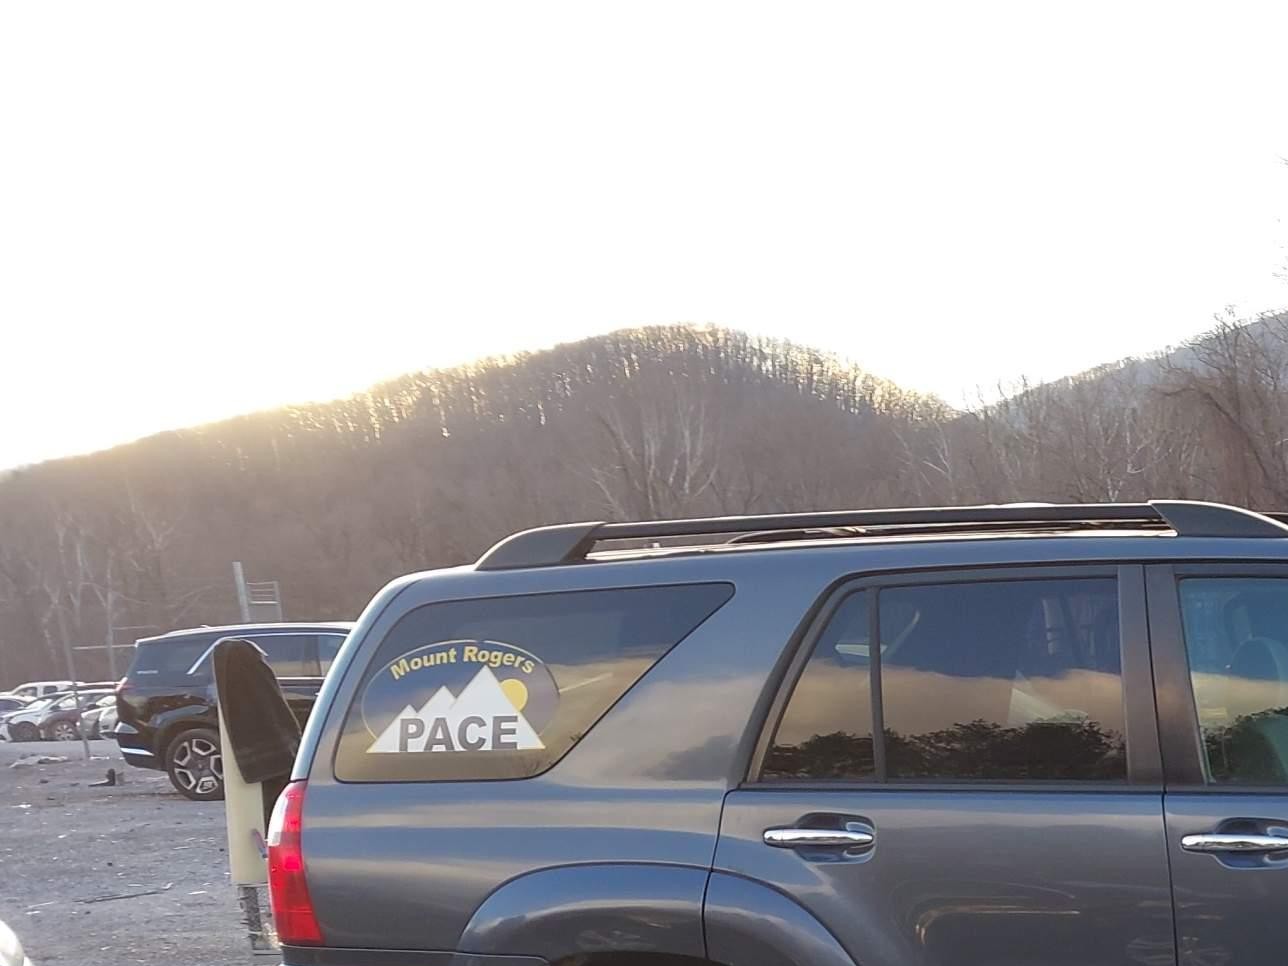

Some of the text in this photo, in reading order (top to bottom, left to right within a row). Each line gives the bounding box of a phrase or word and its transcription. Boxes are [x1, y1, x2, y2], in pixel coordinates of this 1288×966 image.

[390, 645, 535, 680] Mount Rogers
[399, 715, 518, 752] PACE
